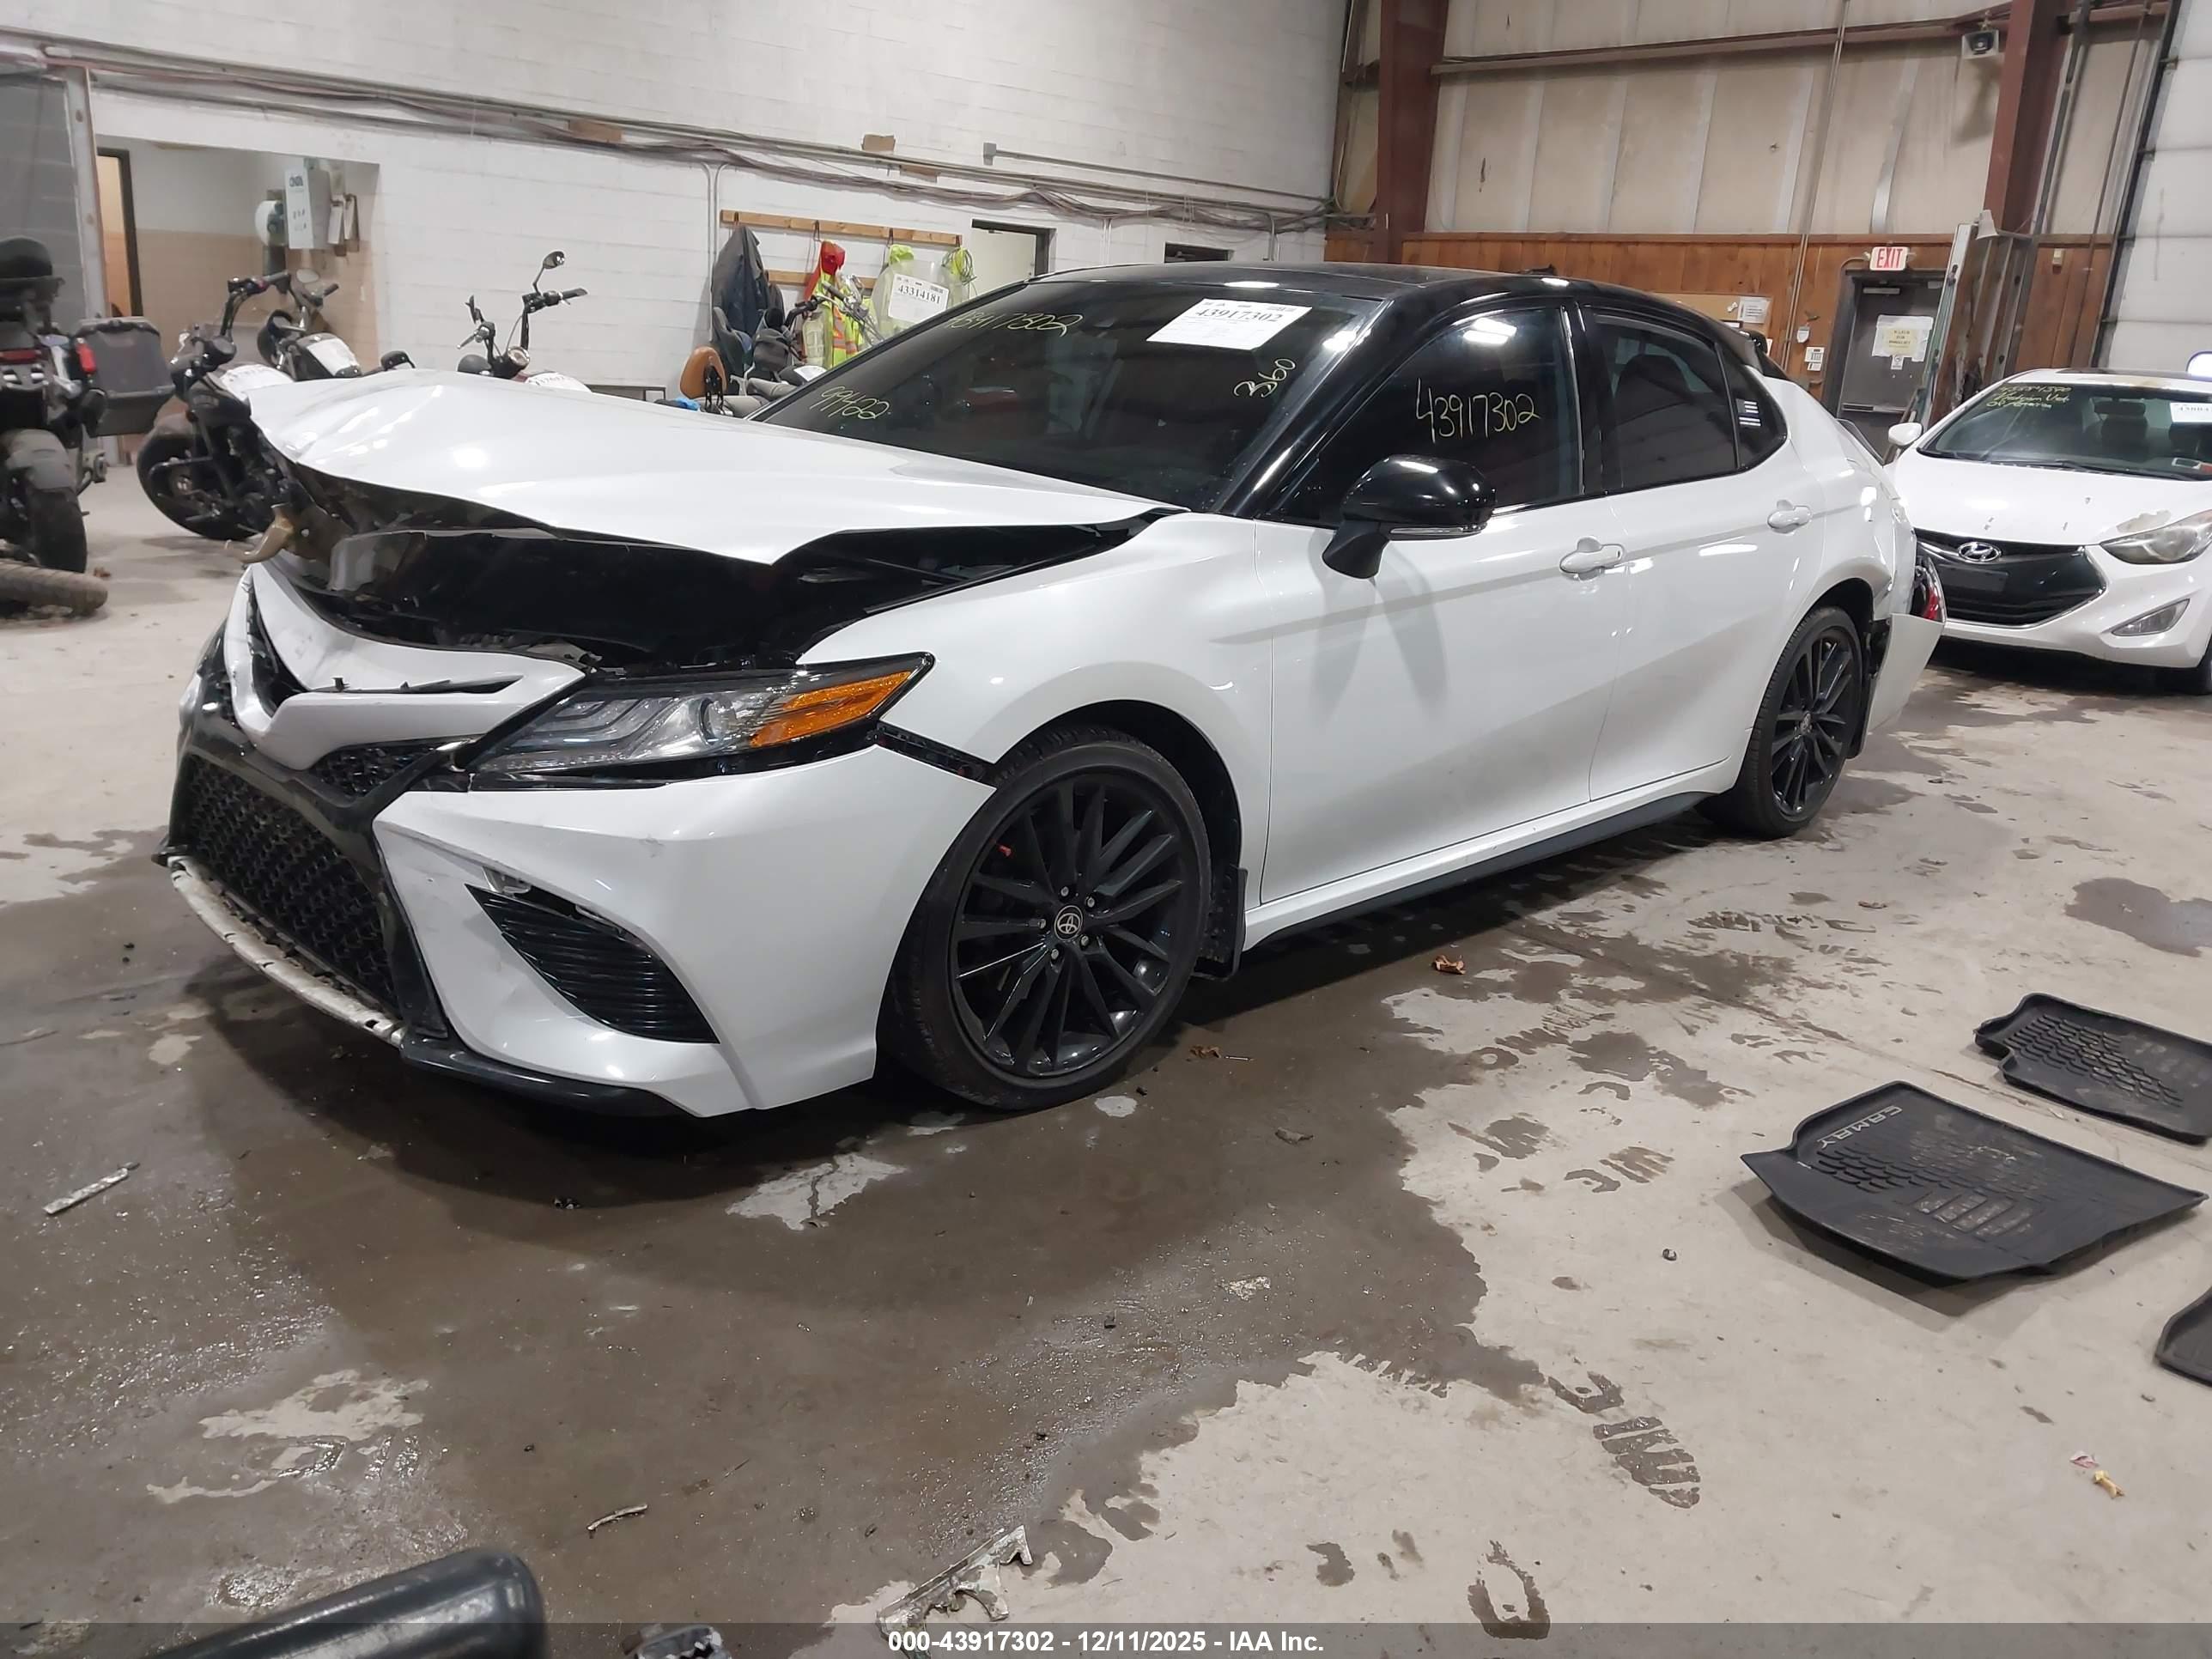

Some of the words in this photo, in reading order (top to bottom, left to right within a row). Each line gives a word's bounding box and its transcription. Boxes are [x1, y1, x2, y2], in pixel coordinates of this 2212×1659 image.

[1876, 247, 1903, 268] EXIT
[898, 284, 941, 305] 43314181
[1194, 307, 1285, 323] 43917302
[1233, 357, 1297, 398] 360
[1415, 377, 1542, 444] 43917302
[1816, 1104, 1903, 1149] CAMRY
